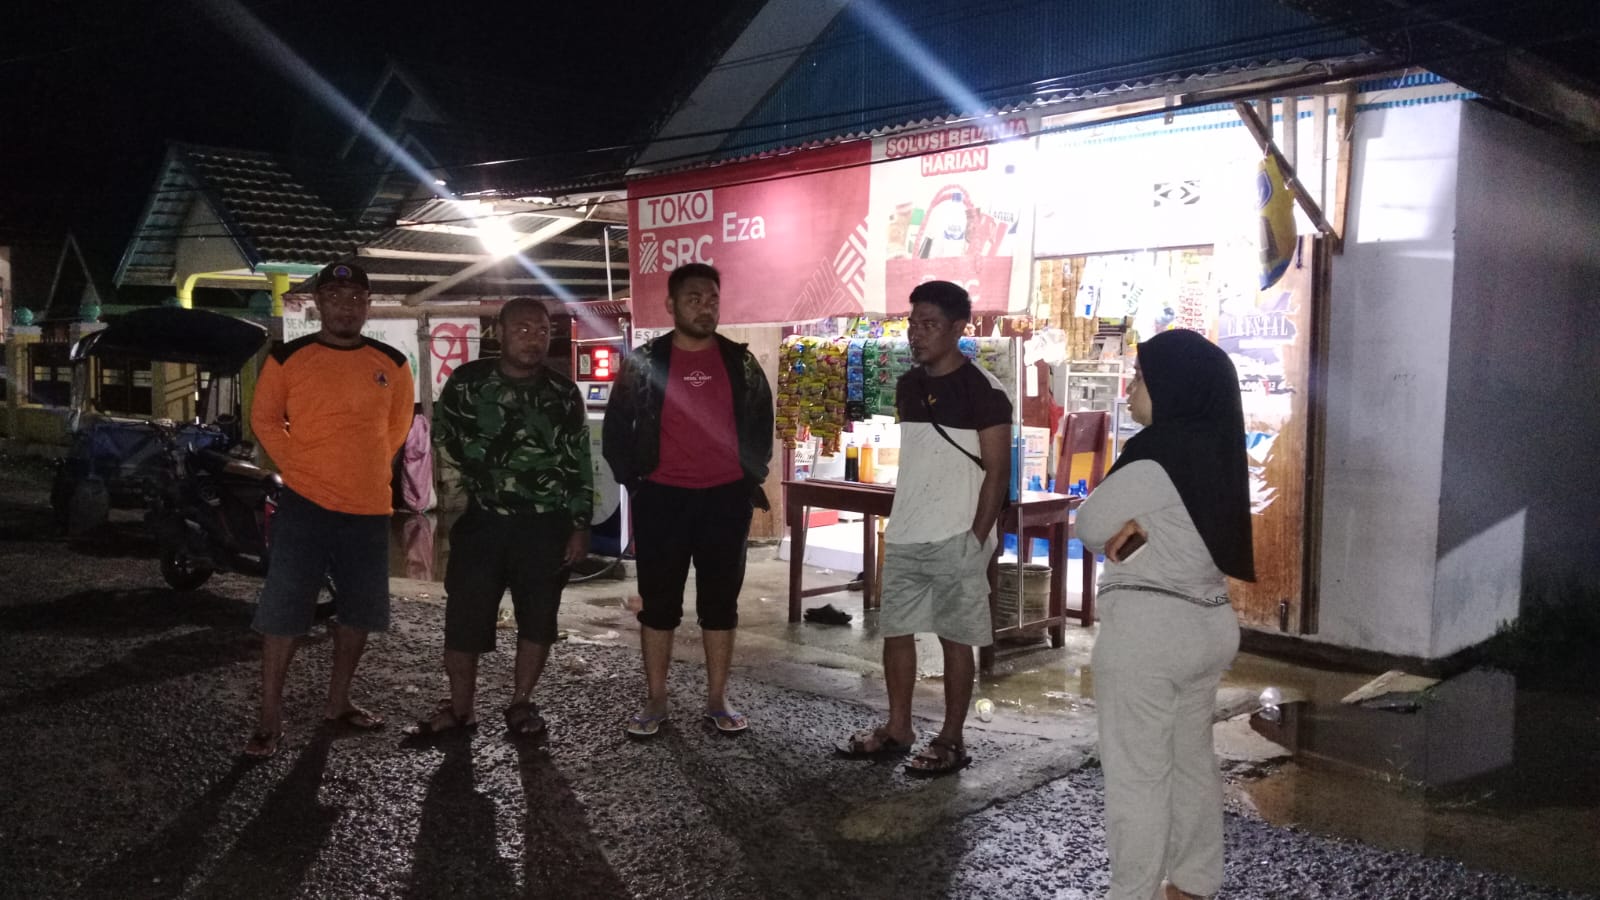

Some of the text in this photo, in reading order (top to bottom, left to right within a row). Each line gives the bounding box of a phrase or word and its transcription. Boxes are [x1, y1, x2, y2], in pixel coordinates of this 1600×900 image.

[887, 133, 944, 156] SOLUSI
[922, 150, 986, 173] HARIAN
[647, 192, 708, 225] TOKO
[722, 212, 766, 243] Eza
[662, 234, 714, 271] SRC
